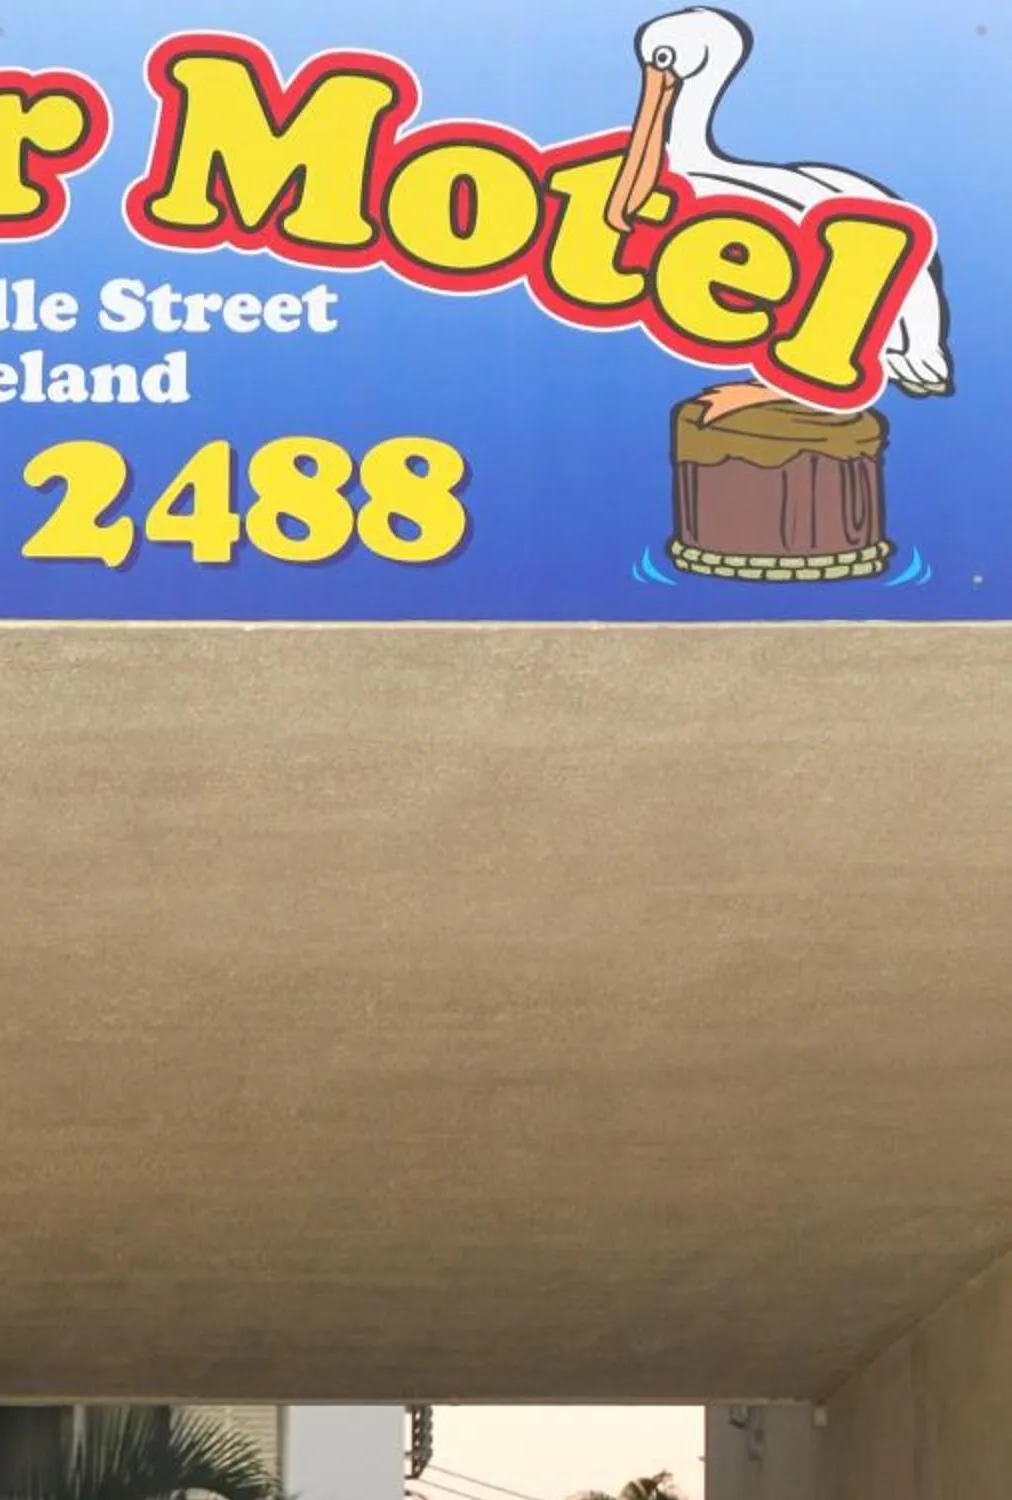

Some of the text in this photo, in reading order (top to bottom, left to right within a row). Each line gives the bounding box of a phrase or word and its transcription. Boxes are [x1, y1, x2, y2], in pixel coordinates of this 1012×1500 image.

[146, 50, 914, 392] Motel
[97, 277, 340, 334] Street
[20, 435, 471, 568] 2488
